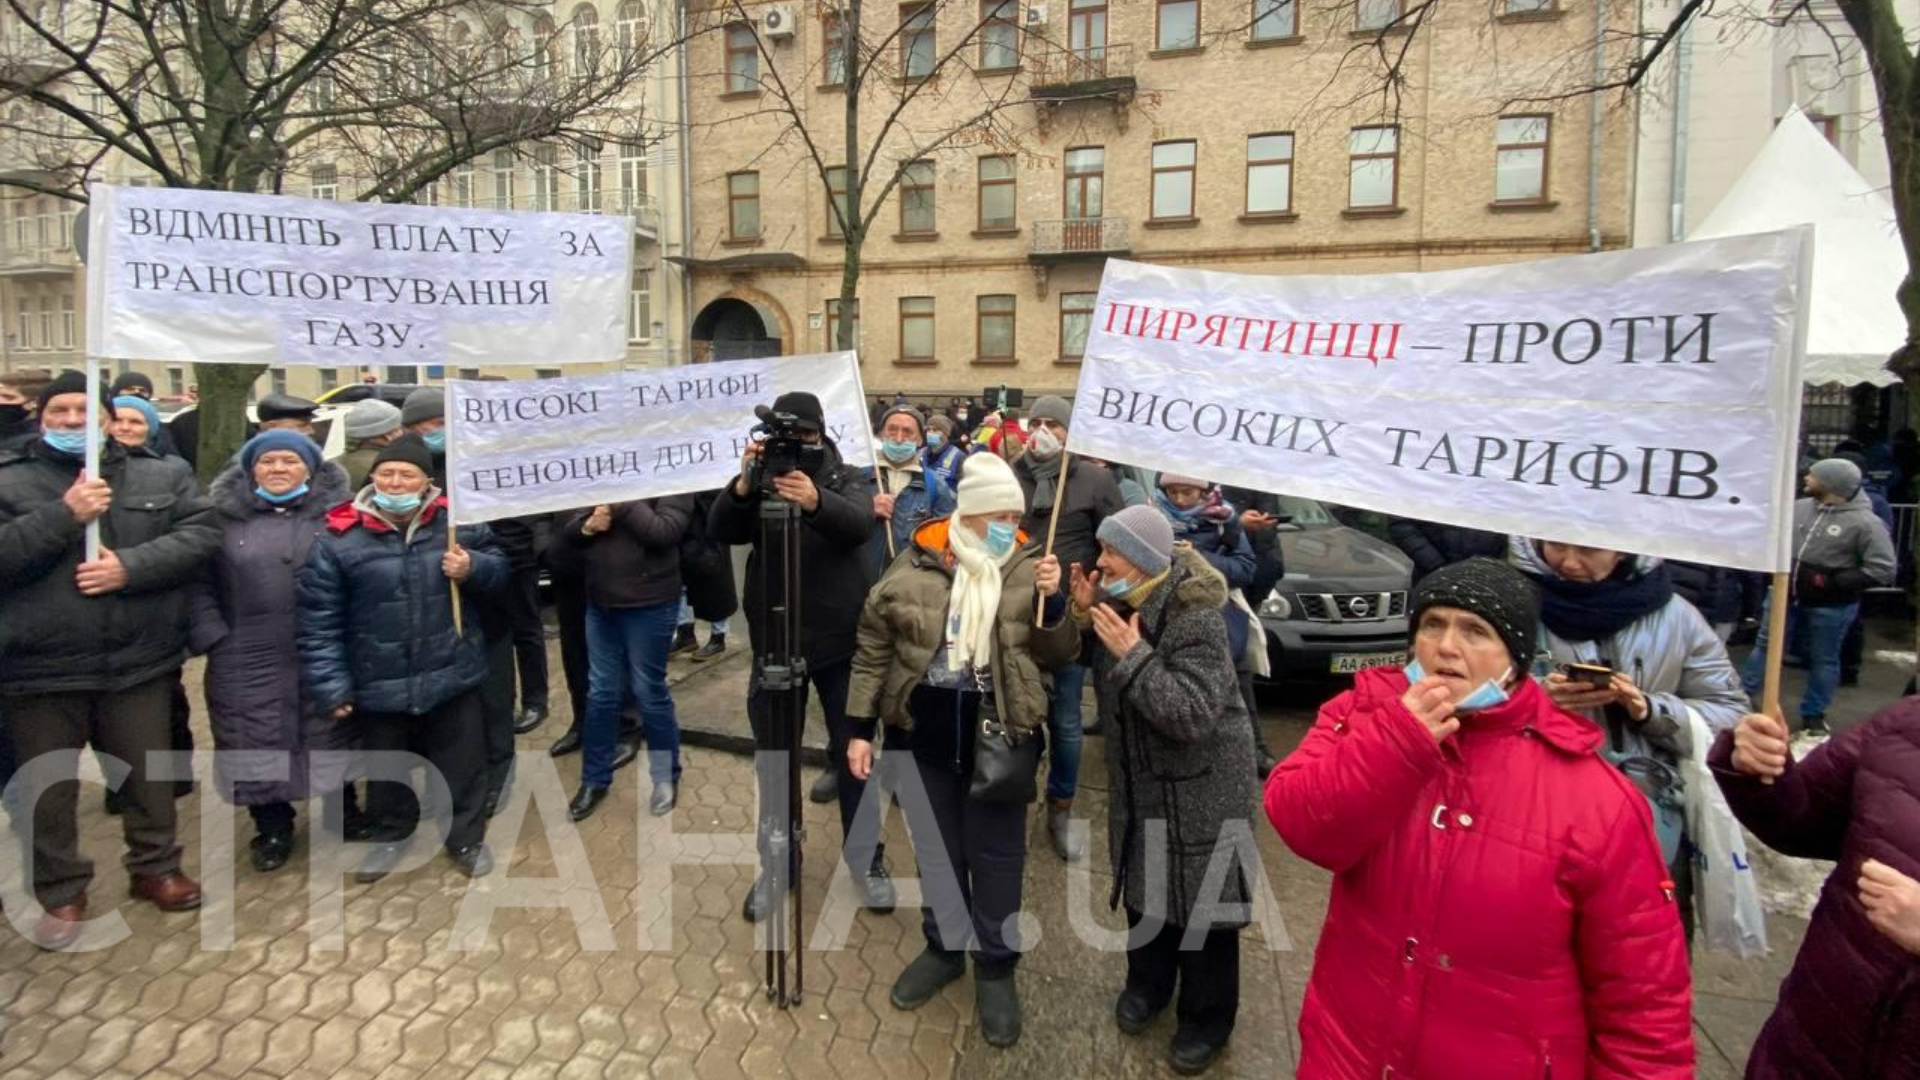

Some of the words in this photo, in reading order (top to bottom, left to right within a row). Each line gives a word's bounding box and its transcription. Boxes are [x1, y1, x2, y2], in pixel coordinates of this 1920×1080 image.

[129, 207, 341, 247] ВІДМІНІТЬ
[370, 223, 512, 255] ПЛАТУ
[560, 230, 605, 257] ЗА
[125, 261, 550, 306] ТРАНСПОРТУВАННЯ
[305, 319, 426, 350] ГАЗУ.
[1104, 302, 1404, 368] ПИРЯТИНЦІ
[1460, 312, 1719, 366] ПРОТИ
[464, 390, 600, 424] ВИСОКІ
[631, 373, 760, 408] ТАРИФИ
[471, 450, 641, 492] ГЕНОЦИД
[653, 440, 715, 473] ДЛЯ
[1097, 386, 1348, 458] ВИСОКИХ
[1384, 426, 1741, 506] ТАРИФІВ.
